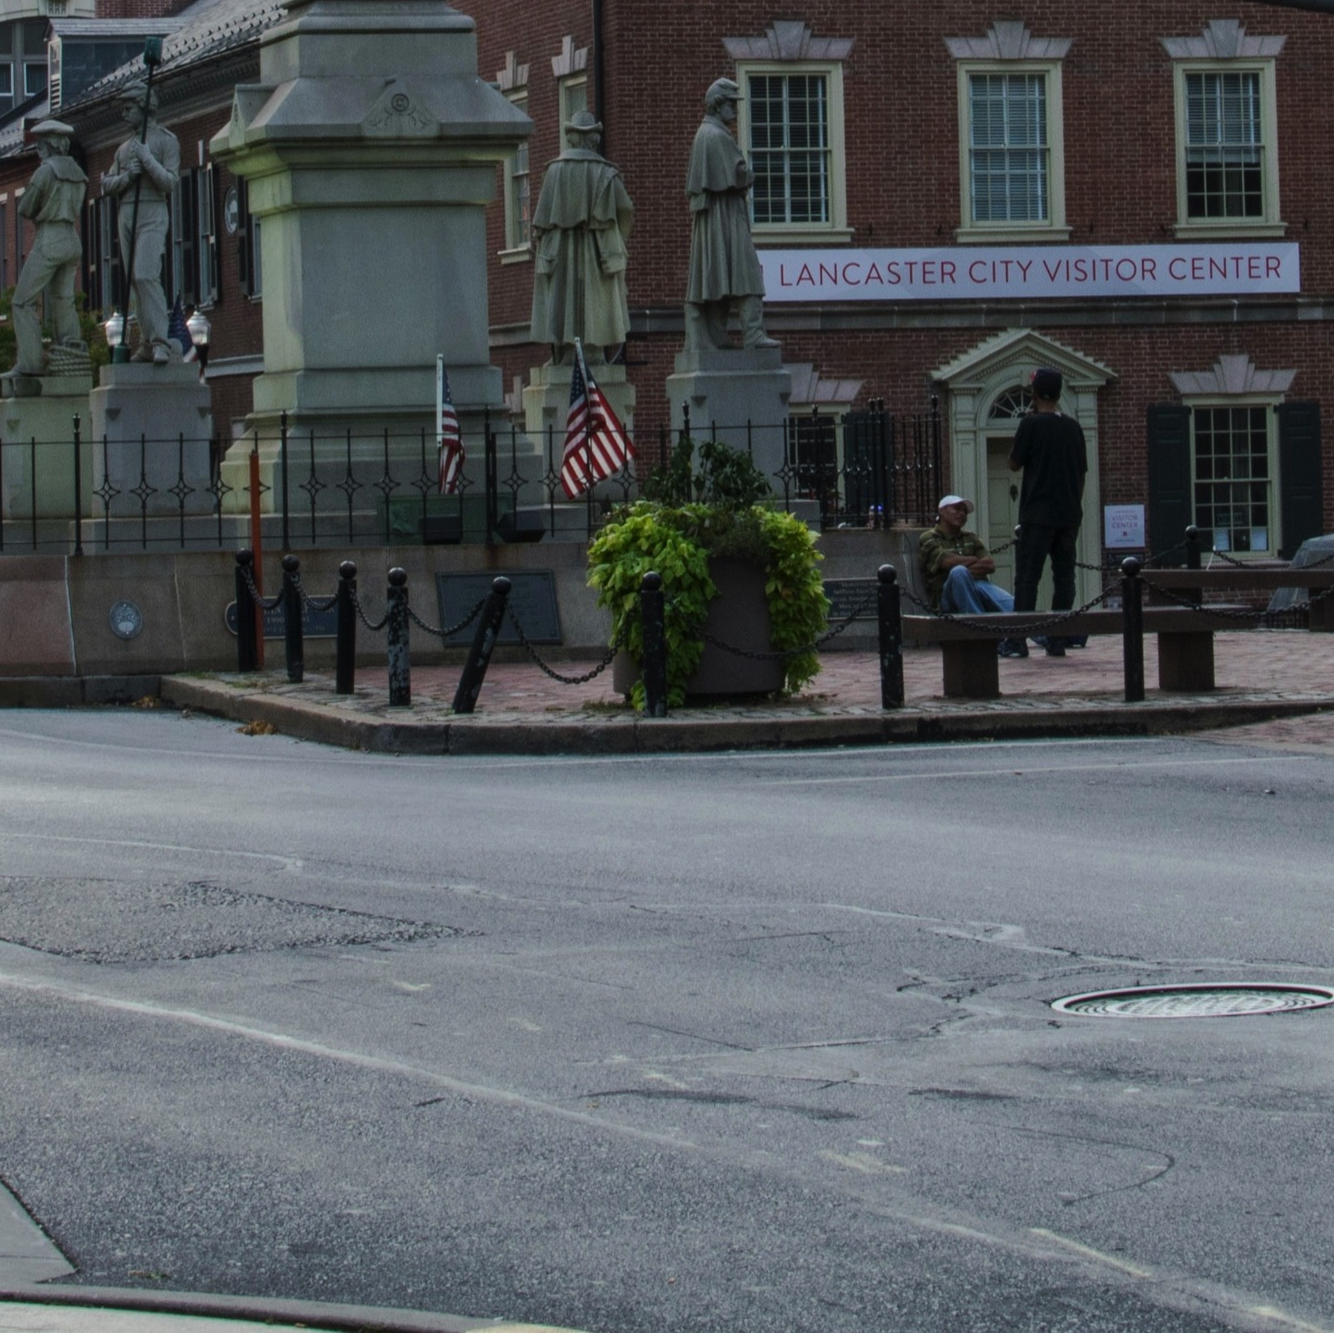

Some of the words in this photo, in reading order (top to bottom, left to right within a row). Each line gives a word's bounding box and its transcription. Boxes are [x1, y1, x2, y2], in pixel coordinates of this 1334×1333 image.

[780, 261, 956, 286] LANCASTER
[968, 260, 1033, 283] CITY
[1043, 258, 1157, 282] VISITOR
[1169, 255, 1281, 281] CENTER
